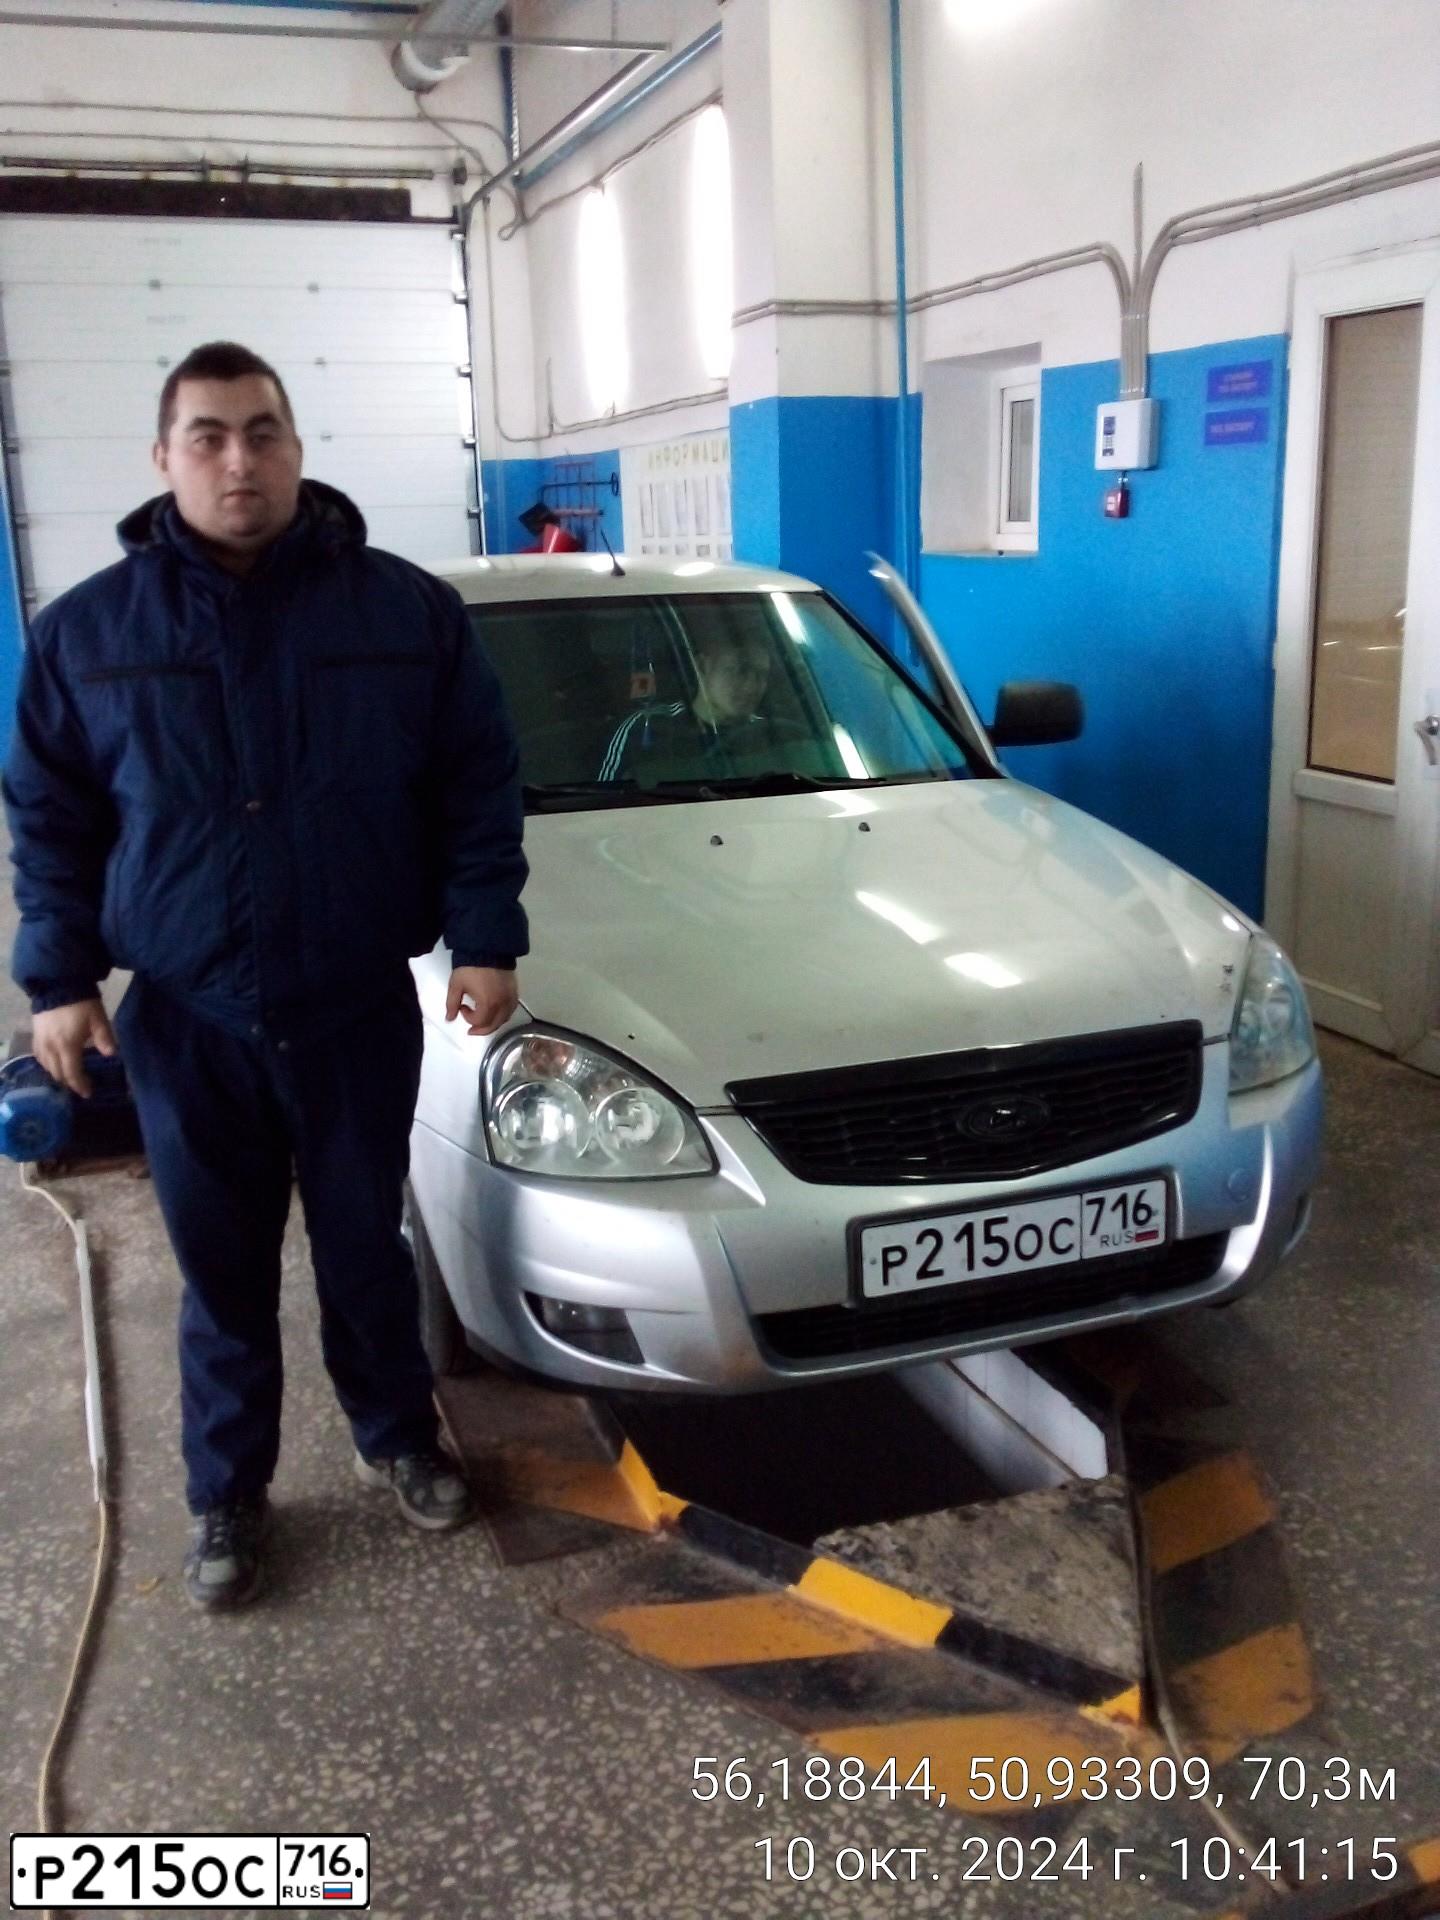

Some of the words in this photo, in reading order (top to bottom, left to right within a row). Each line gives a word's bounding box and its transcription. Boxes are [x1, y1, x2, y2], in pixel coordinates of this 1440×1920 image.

[647, 440, 729, 468] ИНФОРМАЦИ
[1086, 1189, 1152, 1236] 716
[880, 1216, 1075, 1286] Р215ОС
[1100, 1234, 1134, 1248] RUS
